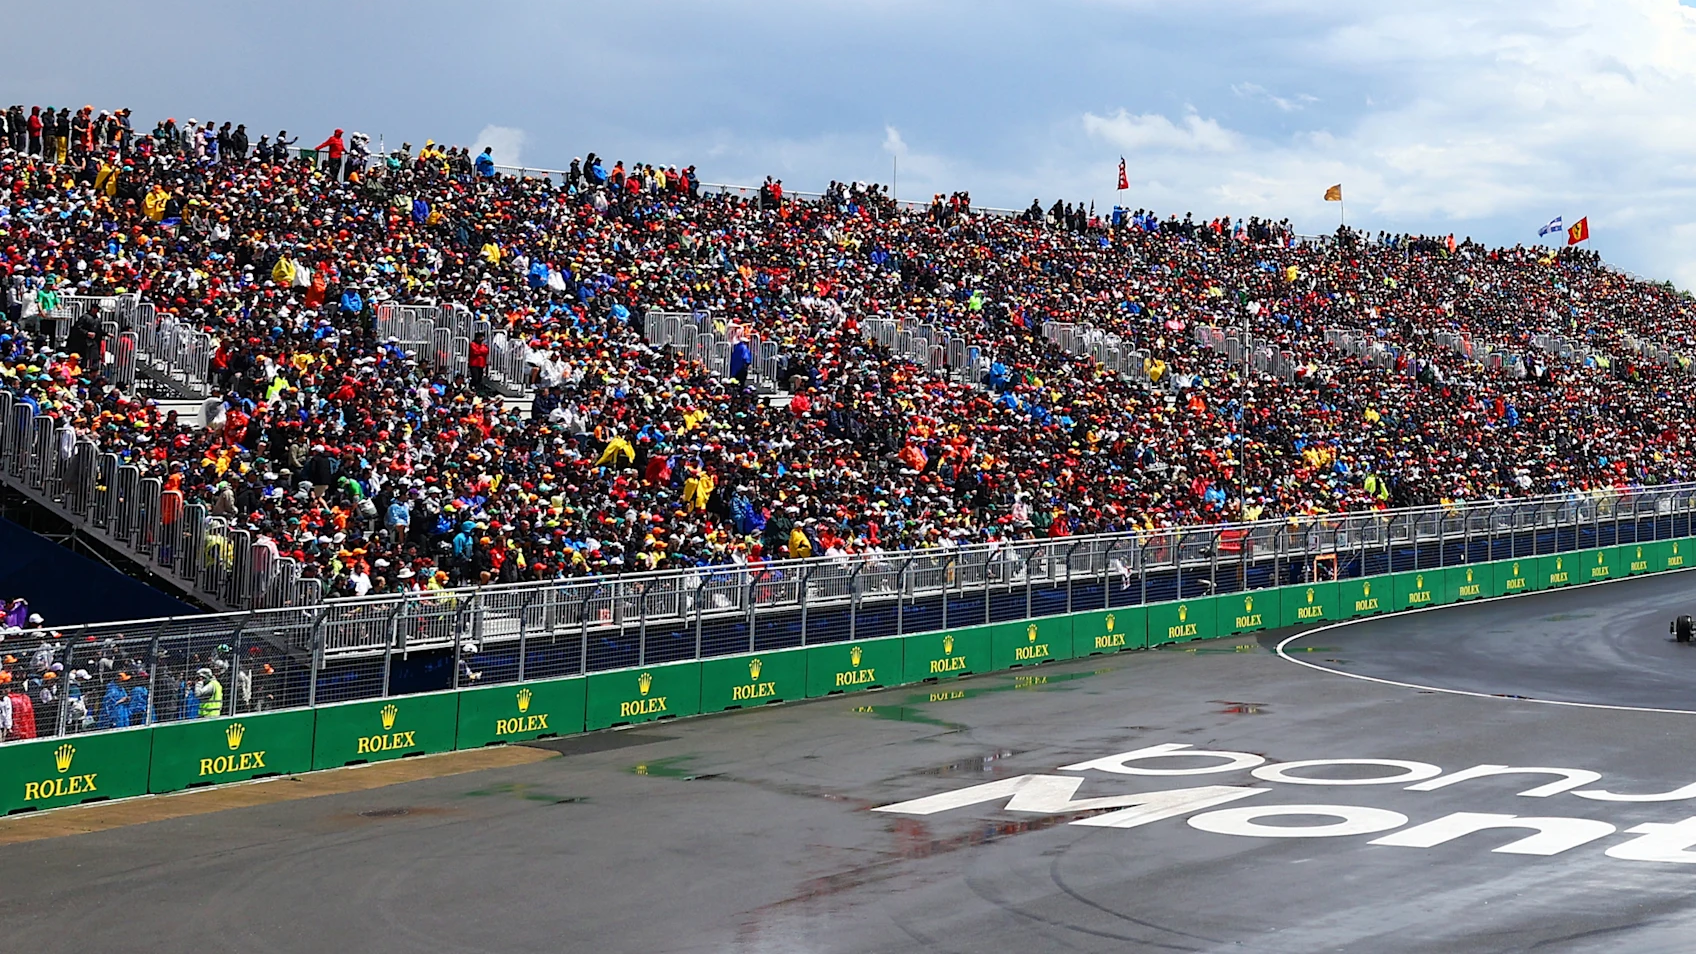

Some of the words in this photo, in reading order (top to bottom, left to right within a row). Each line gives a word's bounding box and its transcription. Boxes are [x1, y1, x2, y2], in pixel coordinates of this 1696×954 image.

[1632, 562, 1646, 570] ROLEX
[1669, 556, 1682, 565] ROLEX
[1551, 572, 1567, 582] ROLEX
[1592, 567, 1608, 576] ROLEX
[1460, 585, 1479, 595] ROLEX
[1507, 579, 1524, 588] ROLEX
[1410, 592, 1430, 602] ROLEX
[1356, 599, 1377, 610] ROLEX
[1298, 606, 1322, 618] ROLEX
[1236, 615, 1261, 627] ROLEX
[1169, 624, 1196, 638] ROLEX
[1096, 634, 1125, 647] ROLEX
[1016, 645, 1048, 660] ROLEX
[931, 657, 965, 672] ROLEX
[836, 669, 874, 686] ROLEX
[733, 682, 775, 700] ROLEX
[621, 697, 666, 716] ROLEX
[497, 714, 548, 734] ROLEX
[358, 731, 415, 753] ROLEX
[200, 751, 265, 775] ROLEX
[25, 774, 96, 800] ROLEX
